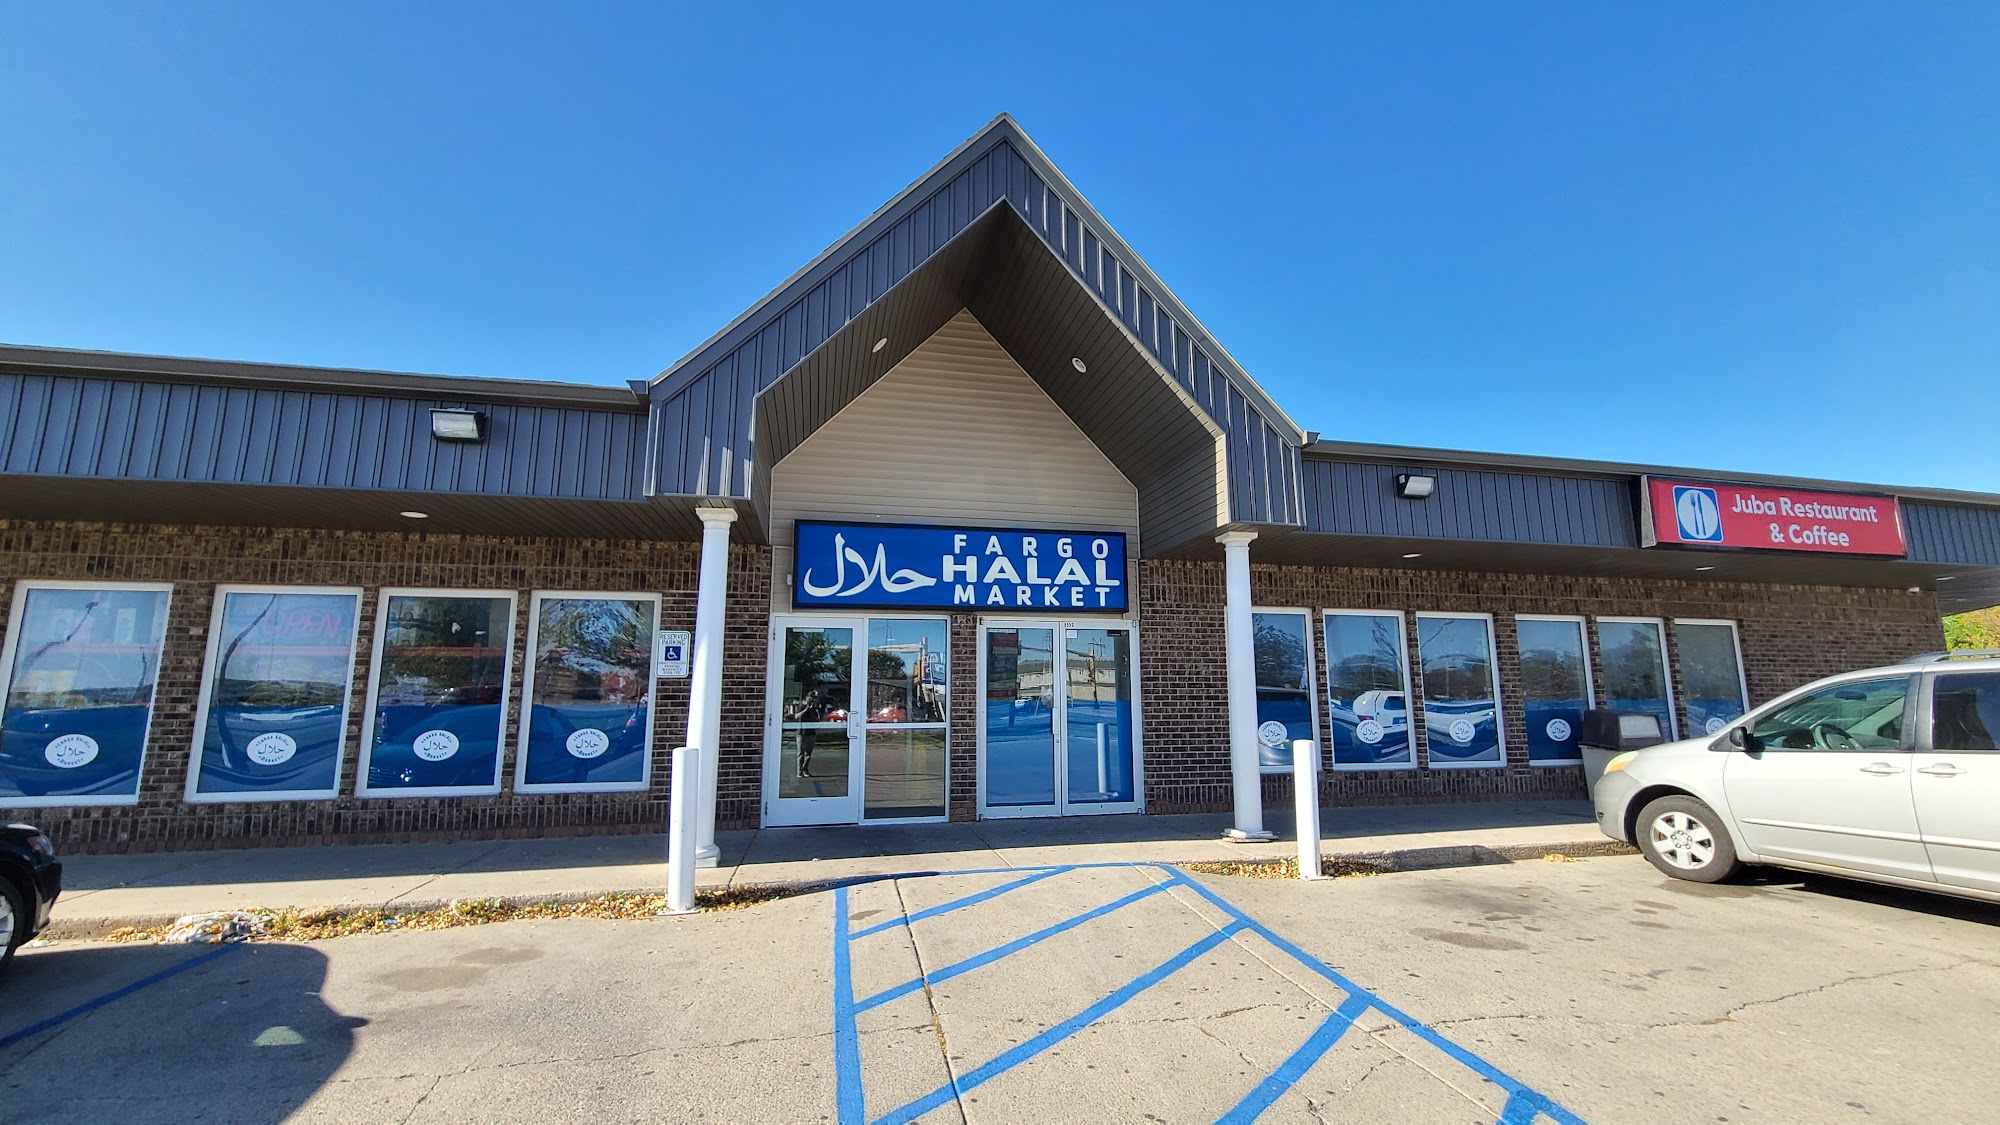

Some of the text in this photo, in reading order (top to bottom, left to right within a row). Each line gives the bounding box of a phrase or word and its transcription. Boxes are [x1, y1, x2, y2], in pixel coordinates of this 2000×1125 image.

[1732, 494, 1878, 523] Juba Restaurant
[954, 534, 1109, 559] FARGO
[1770, 523, 1850, 547] & Coffee
[803, 532, 937, 597] حلال
[942, 554, 1120, 586] HALAL
[954, 584, 1110, 607] MARKET
[261, 609, 344, 640] OPEN
